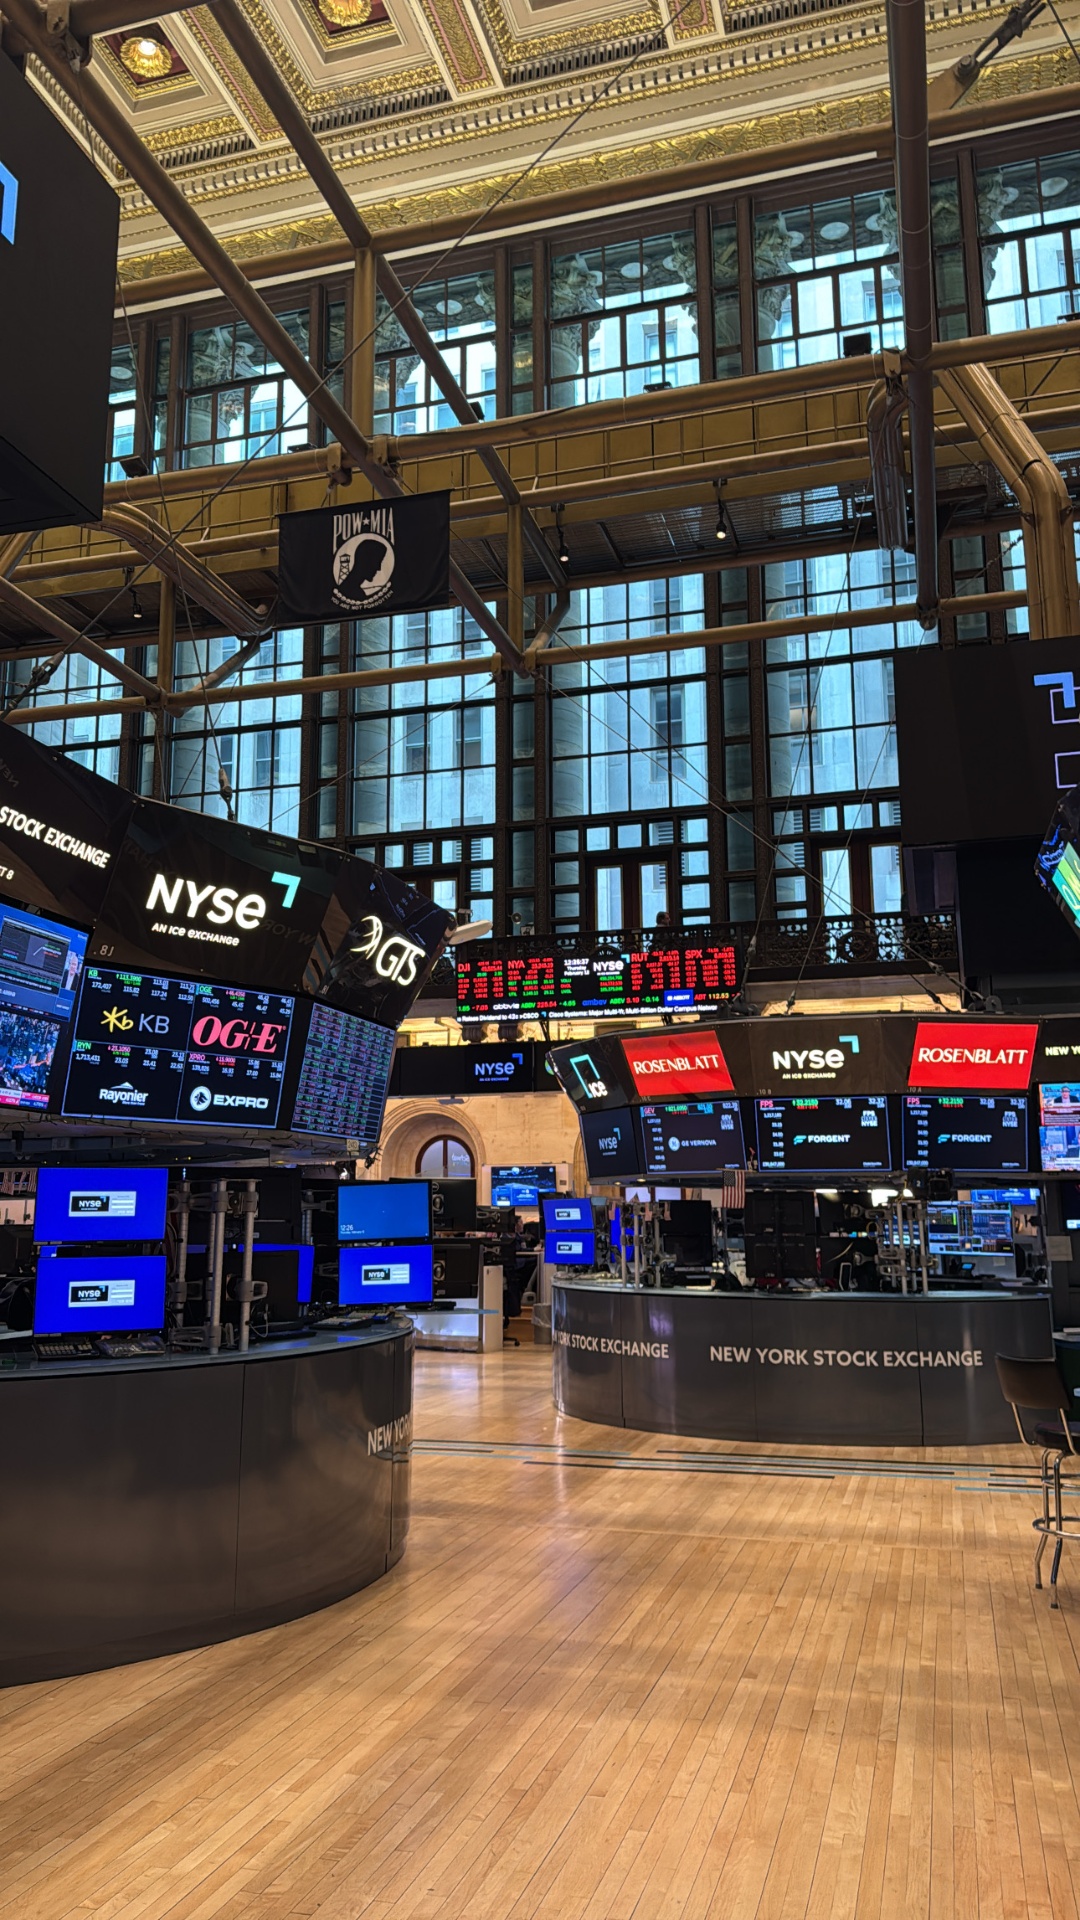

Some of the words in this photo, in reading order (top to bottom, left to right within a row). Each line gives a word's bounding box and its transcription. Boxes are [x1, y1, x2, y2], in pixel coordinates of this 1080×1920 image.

[332, 511, 364, 555] POW
[370, 506, 394, 546] MIA
[364, 590, 394, 610] FORGOTTEN
[0, 806, 46, 840] STOCK
[44, 827, 111, 868] EXCHANGE
[152, 922, 168, 934] AN
[376, 936, 426, 986] GTS
[631, 952, 649, 962] RUT
[685, 949, 702, 959] SPX
[458, 963, 470, 972] DJI
[508, 960, 525, 969] NYA
[88, 969, 98, 977] KB
[199, 986, 213, 994] OGE
[138, 1013, 170, 1034] KB
[76, 1042, 91, 1050] RYN
[1045, 1046, 1069, 1056] NEW
[918, 1048, 1028, 1064] ROSENBLATT
[633, 1054, 719, 1074] ROSENBLATT
[99, 1088, 149, 1103] Rayonier
[213, 1094, 269, 1109] EXPRO
[808, 1134, 850, 1143] FORGENT
[572, 1334, 599, 1352] STOCK
[600, 1338, 670, 1359] EXCHANGE
[710, 1346, 751, 1363] NEW
[756, 1348, 809, 1366] YORK
[813, 1350, 879, 1367] STOCK
[883, 1351, 983, 1367] EXCHANGE
[367, 1421, 393, 1456] NEW
